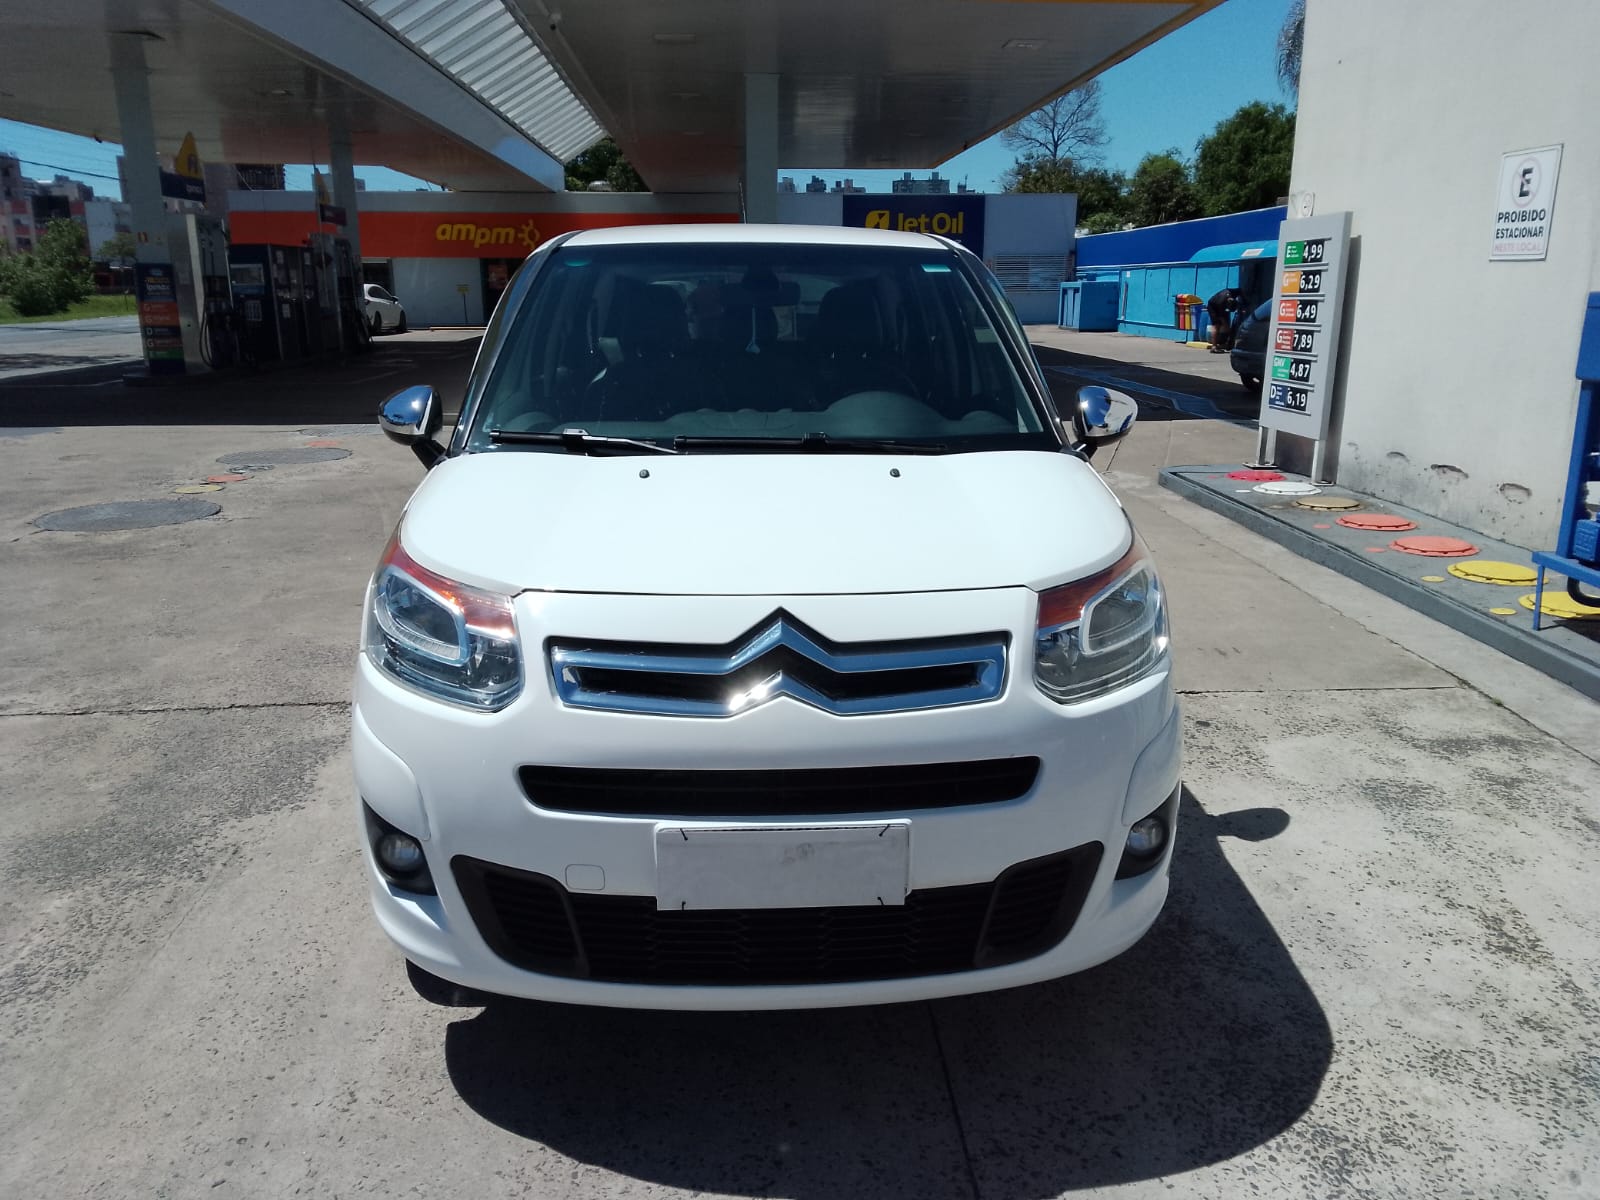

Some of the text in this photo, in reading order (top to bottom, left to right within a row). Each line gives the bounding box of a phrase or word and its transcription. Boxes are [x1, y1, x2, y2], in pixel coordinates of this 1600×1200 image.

[1518, 167, 1534, 198] E
[931, 211, 964, 235] Oil
[1497, 208, 1547, 223] PROIBIDO
[435, 223, 516, 249] ampm
[1495, 226, 1544, 239] ESTACIONAR
[1303, 244, 1323, 262] 4,99
[1300, 274, 1321, 291] 6,29
[1279, 303, 1286, 317] G
[1296, 304, 1317, 320] 6,49
[1277, 330, 1283, 343] G
[1293, 334, 1313, 350] 7,89
[1290, 363, 1310, 378] 4,87
[1270, 385, 1277, 398] D
[1287, 391, 1307, 407] 6,19
